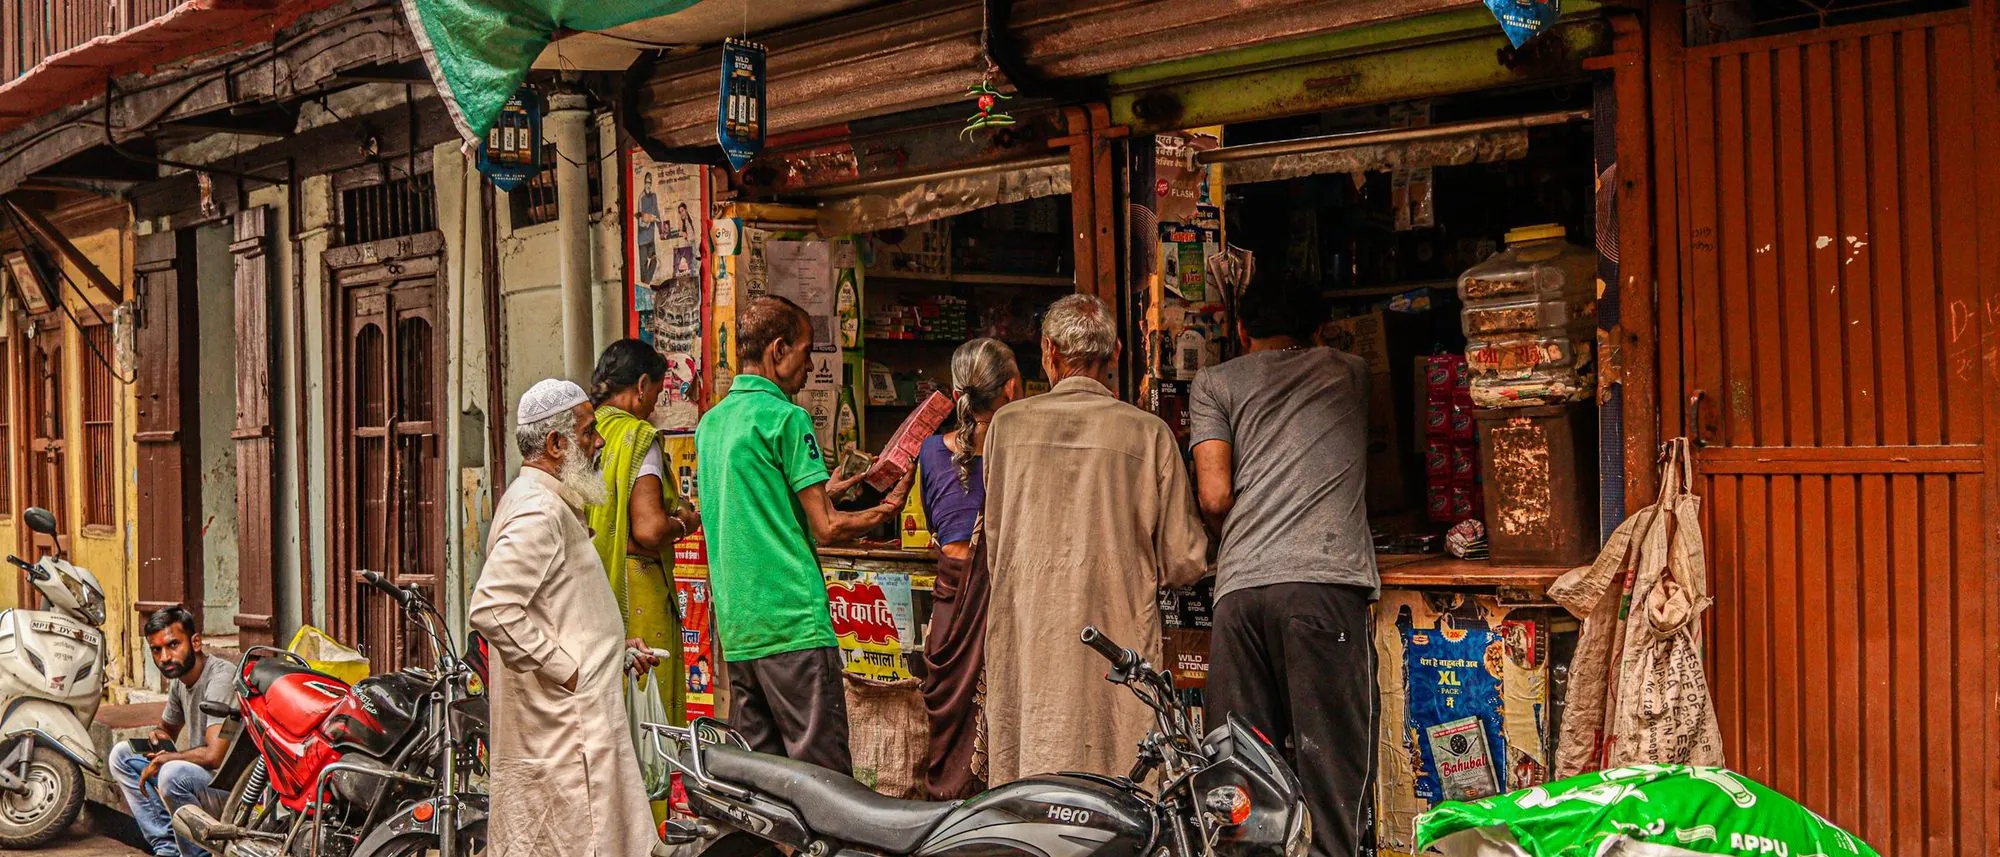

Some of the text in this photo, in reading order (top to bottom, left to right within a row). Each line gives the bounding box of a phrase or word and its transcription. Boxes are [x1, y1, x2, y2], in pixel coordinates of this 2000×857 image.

[1171, 188, 1195, 198] FLASH
[803, 432, 820, 460] 3
[851, 602, 874, 625] का
[1177, 654, 1203, 663] WILD
[1178, 662, 1210, 671] STONE
[1438, 670, 1461, 686] XL
[1047, 805, 1090, 824] Hero
[1730, 832, 1789, 857] APPU
